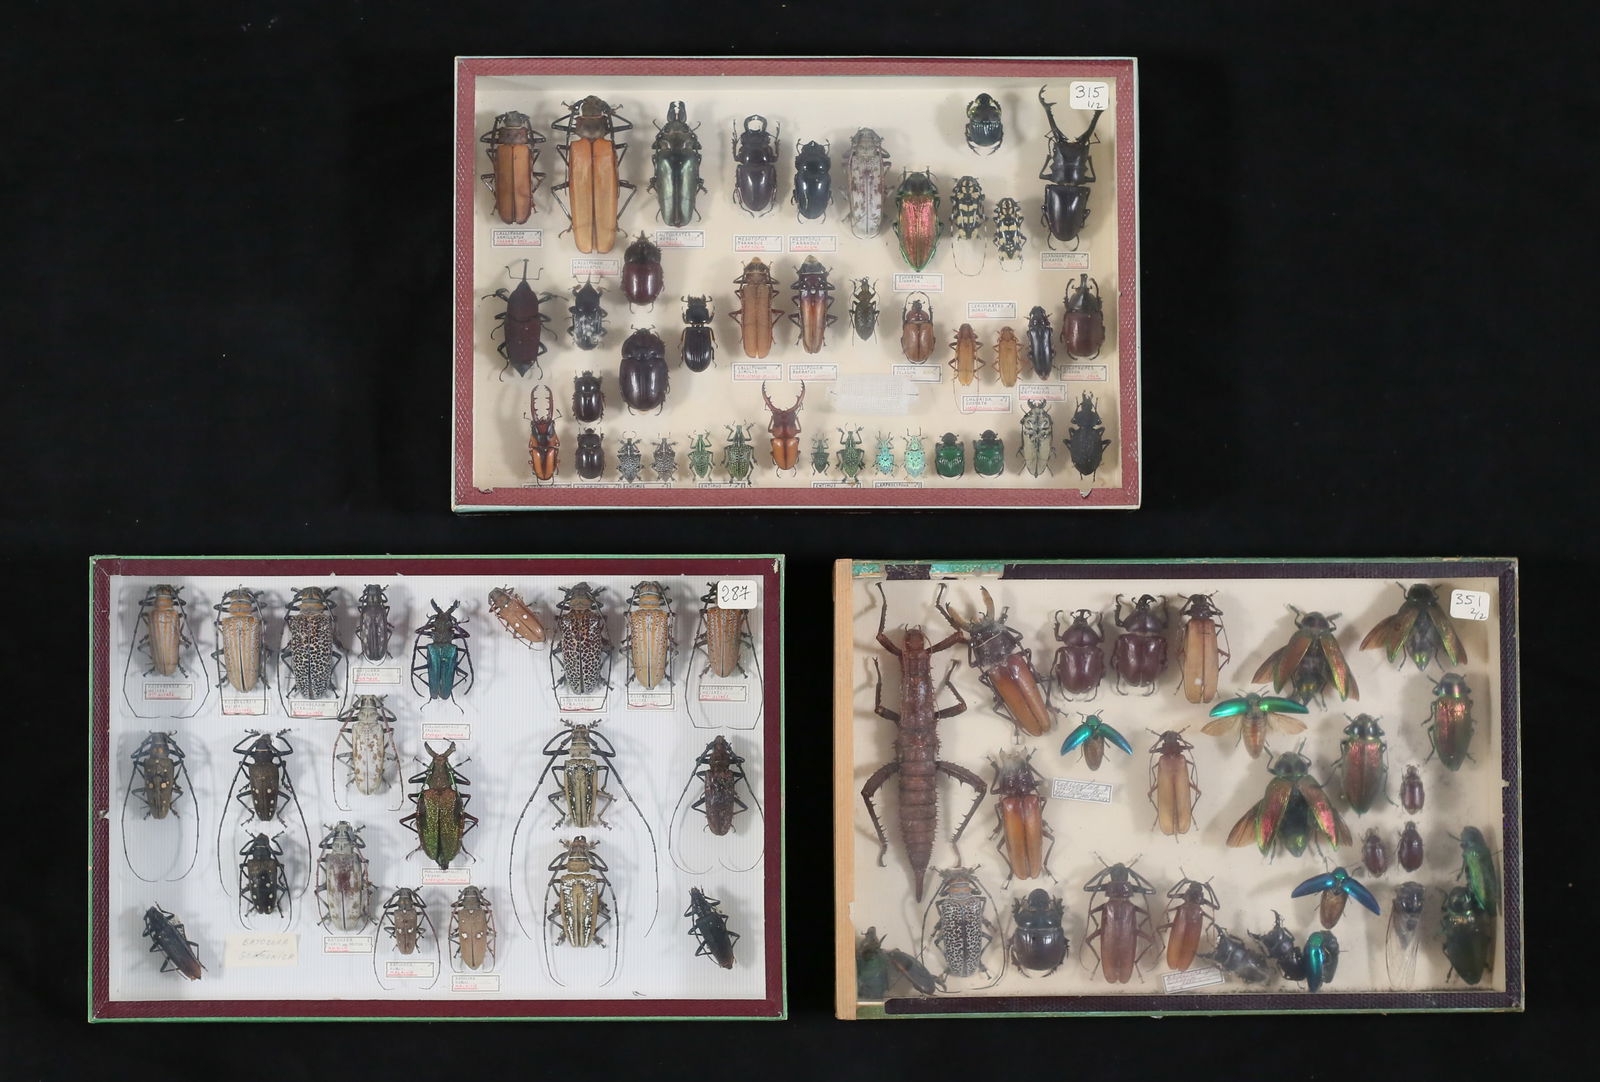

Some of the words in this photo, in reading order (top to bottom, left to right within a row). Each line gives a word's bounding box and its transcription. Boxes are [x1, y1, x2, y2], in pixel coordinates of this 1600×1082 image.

[1075, 85, 1105, 98] 315
[1087, 101, 1103, 109] 1/2
[721, 585, 751, 602] 287
[1456, 594, 1481, 607] 351
